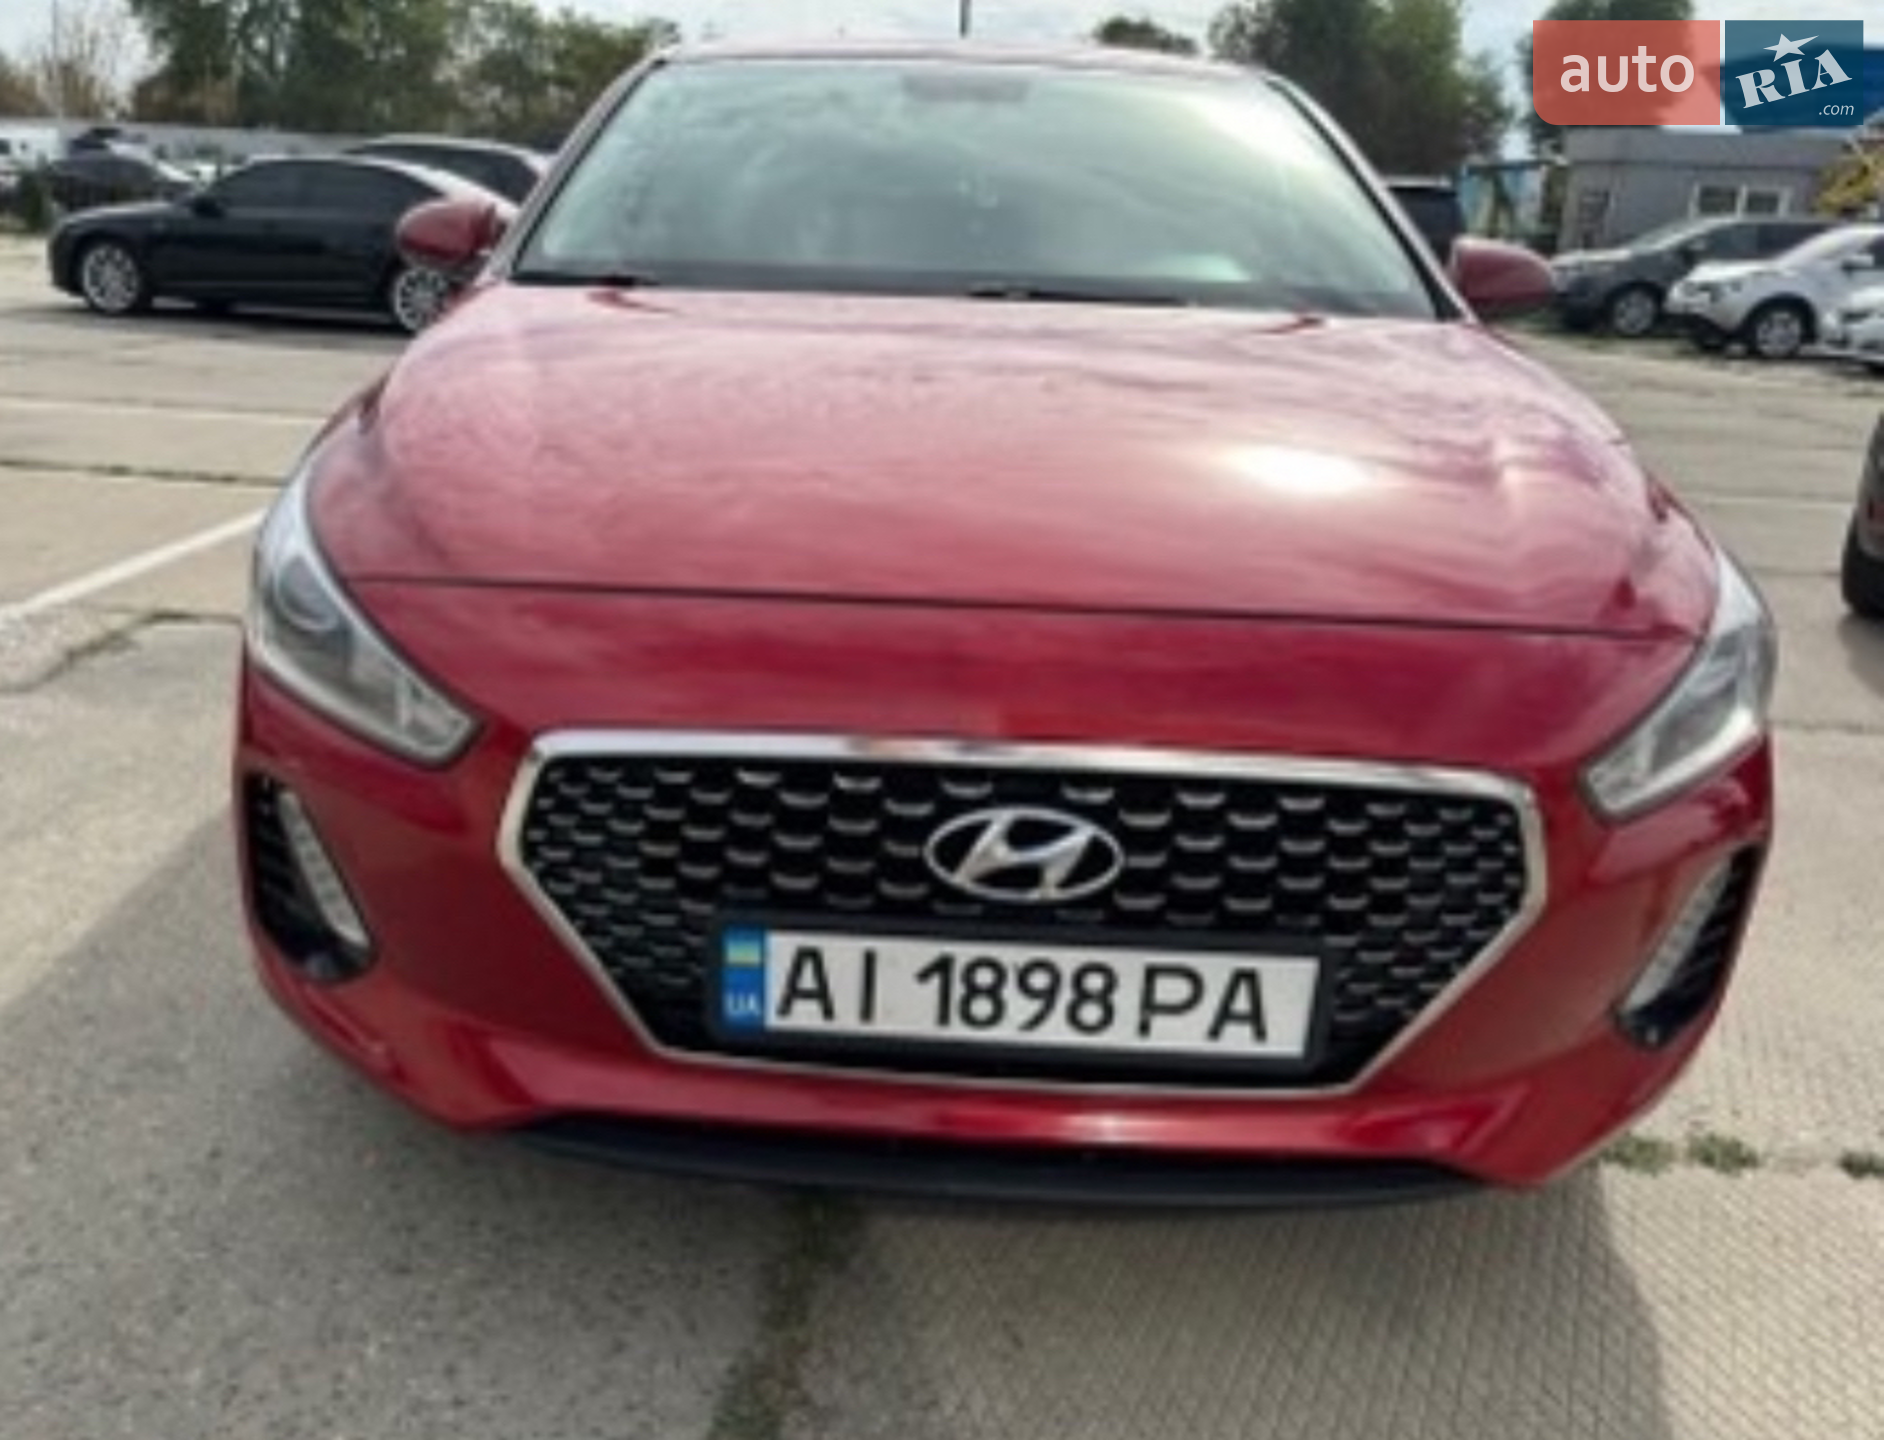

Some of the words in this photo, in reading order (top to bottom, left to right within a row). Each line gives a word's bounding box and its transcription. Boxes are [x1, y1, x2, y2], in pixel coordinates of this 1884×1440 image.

[776, 946, 878, 1022] AI
[915, 952, 1118, 1035] 1898
[1137, 963, 1269, 1042] PA
